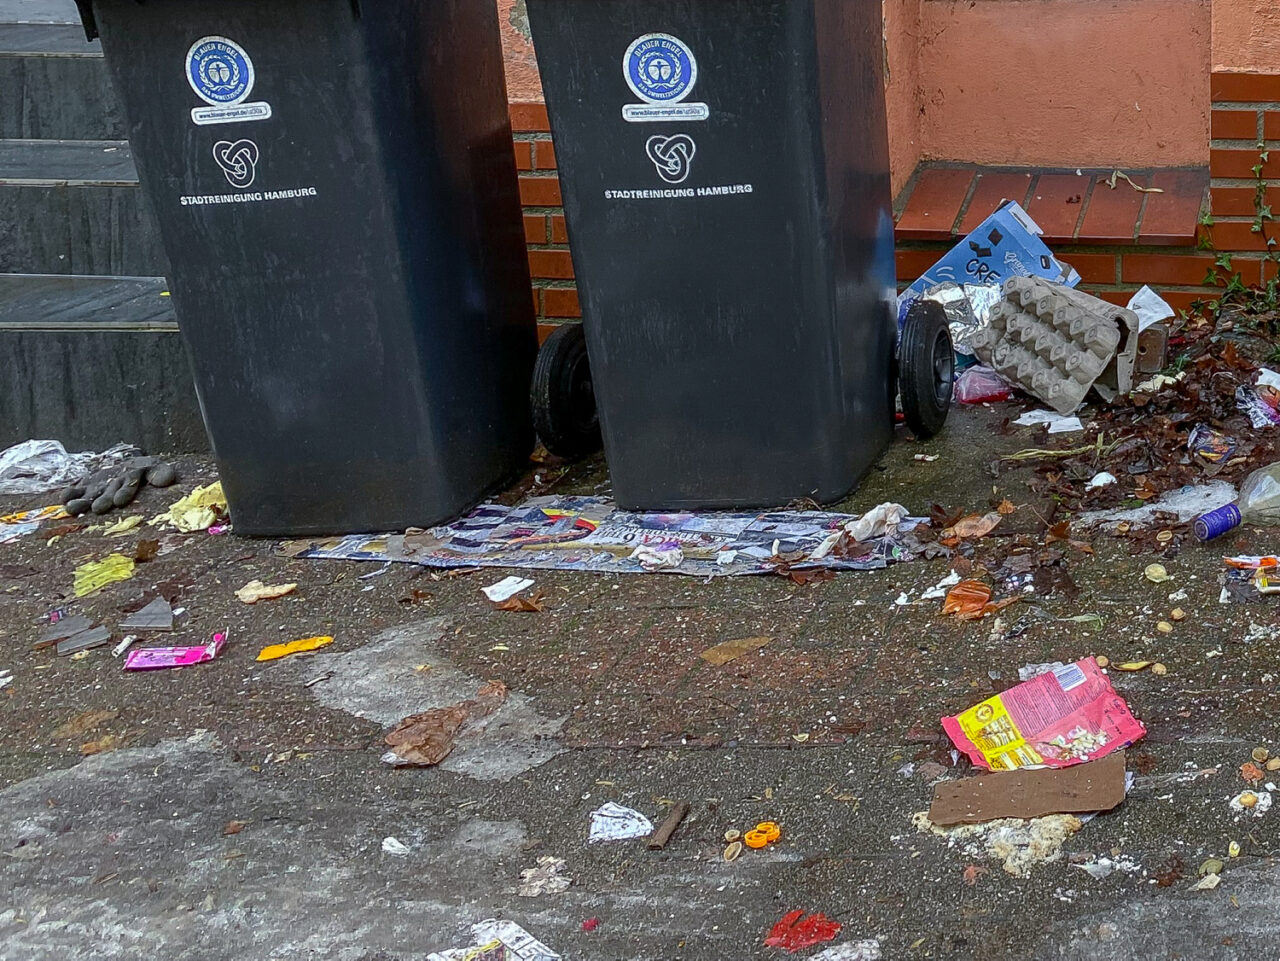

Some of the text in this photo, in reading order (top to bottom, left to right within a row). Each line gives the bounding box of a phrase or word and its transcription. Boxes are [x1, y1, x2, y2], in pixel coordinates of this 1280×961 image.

[194, 43, 239, 61] BLAUER ENGEL
[634, 40, 684, 58] BLAUER ENGEL
[180, 187, 317, 205] STADTREINIGUNG HAMBURG
[605, 184, 753, 199] STADTREINIGUNG HAMBURG
